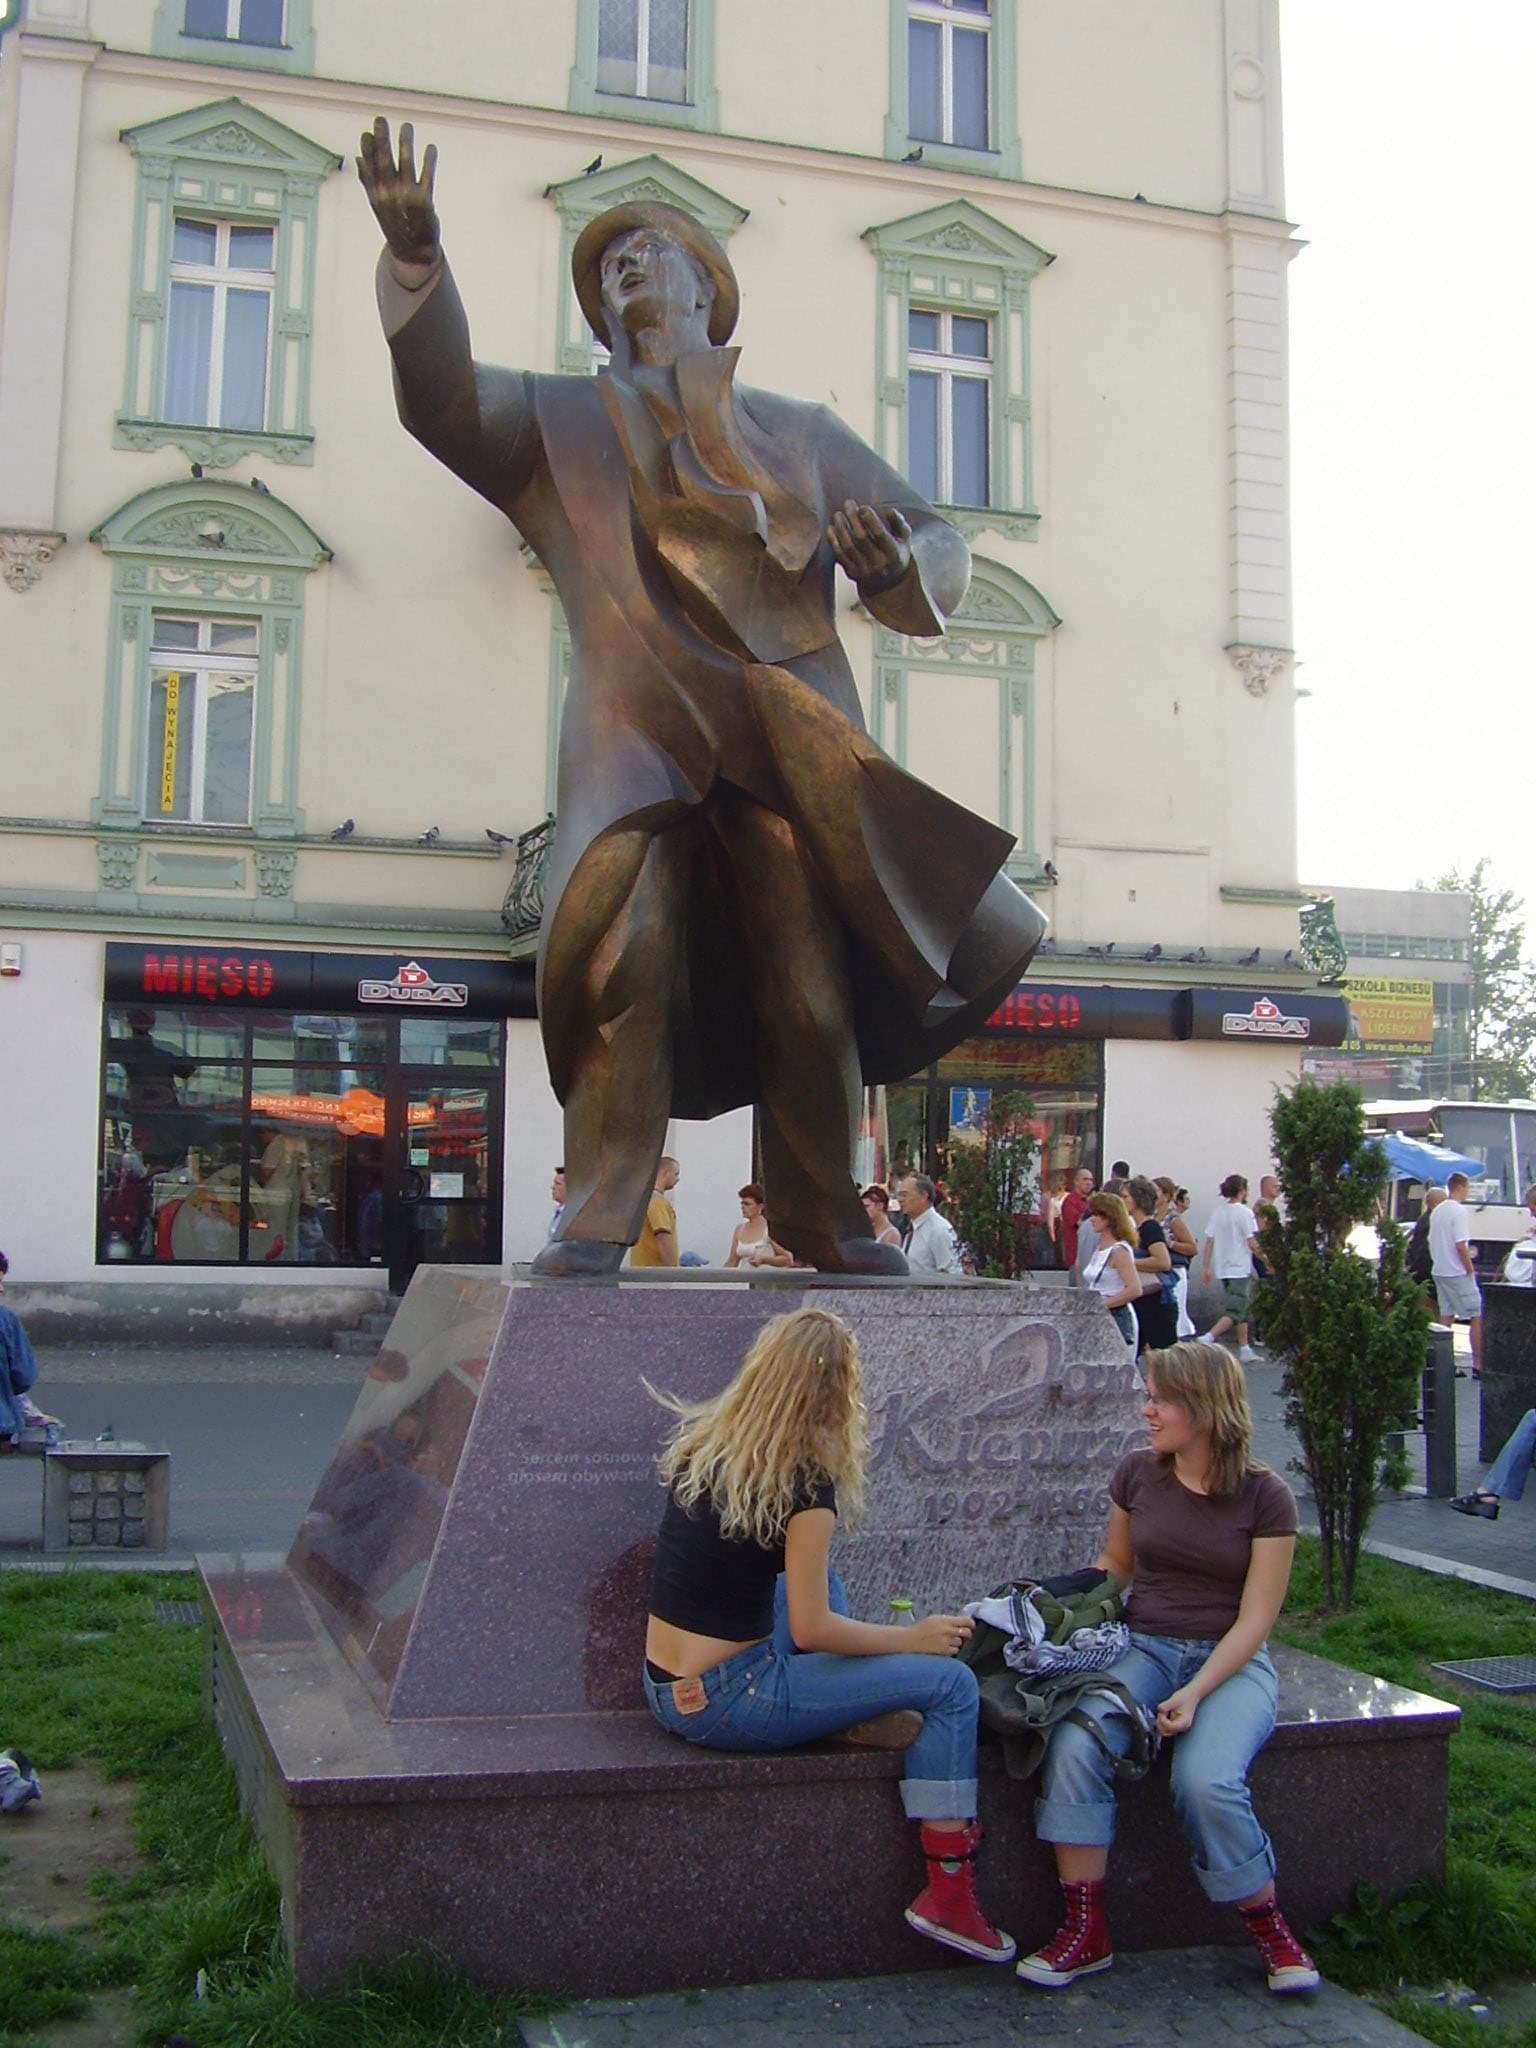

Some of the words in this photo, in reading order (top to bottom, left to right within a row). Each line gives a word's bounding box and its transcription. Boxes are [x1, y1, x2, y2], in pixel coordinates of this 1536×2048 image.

[168, 679, 178, 699] DO
[143, 952, 273, 1004] MIĘSO
[1389, 983, 1432, 995] BIZNESU
[973, 1322, 1145, 1422] Jan
